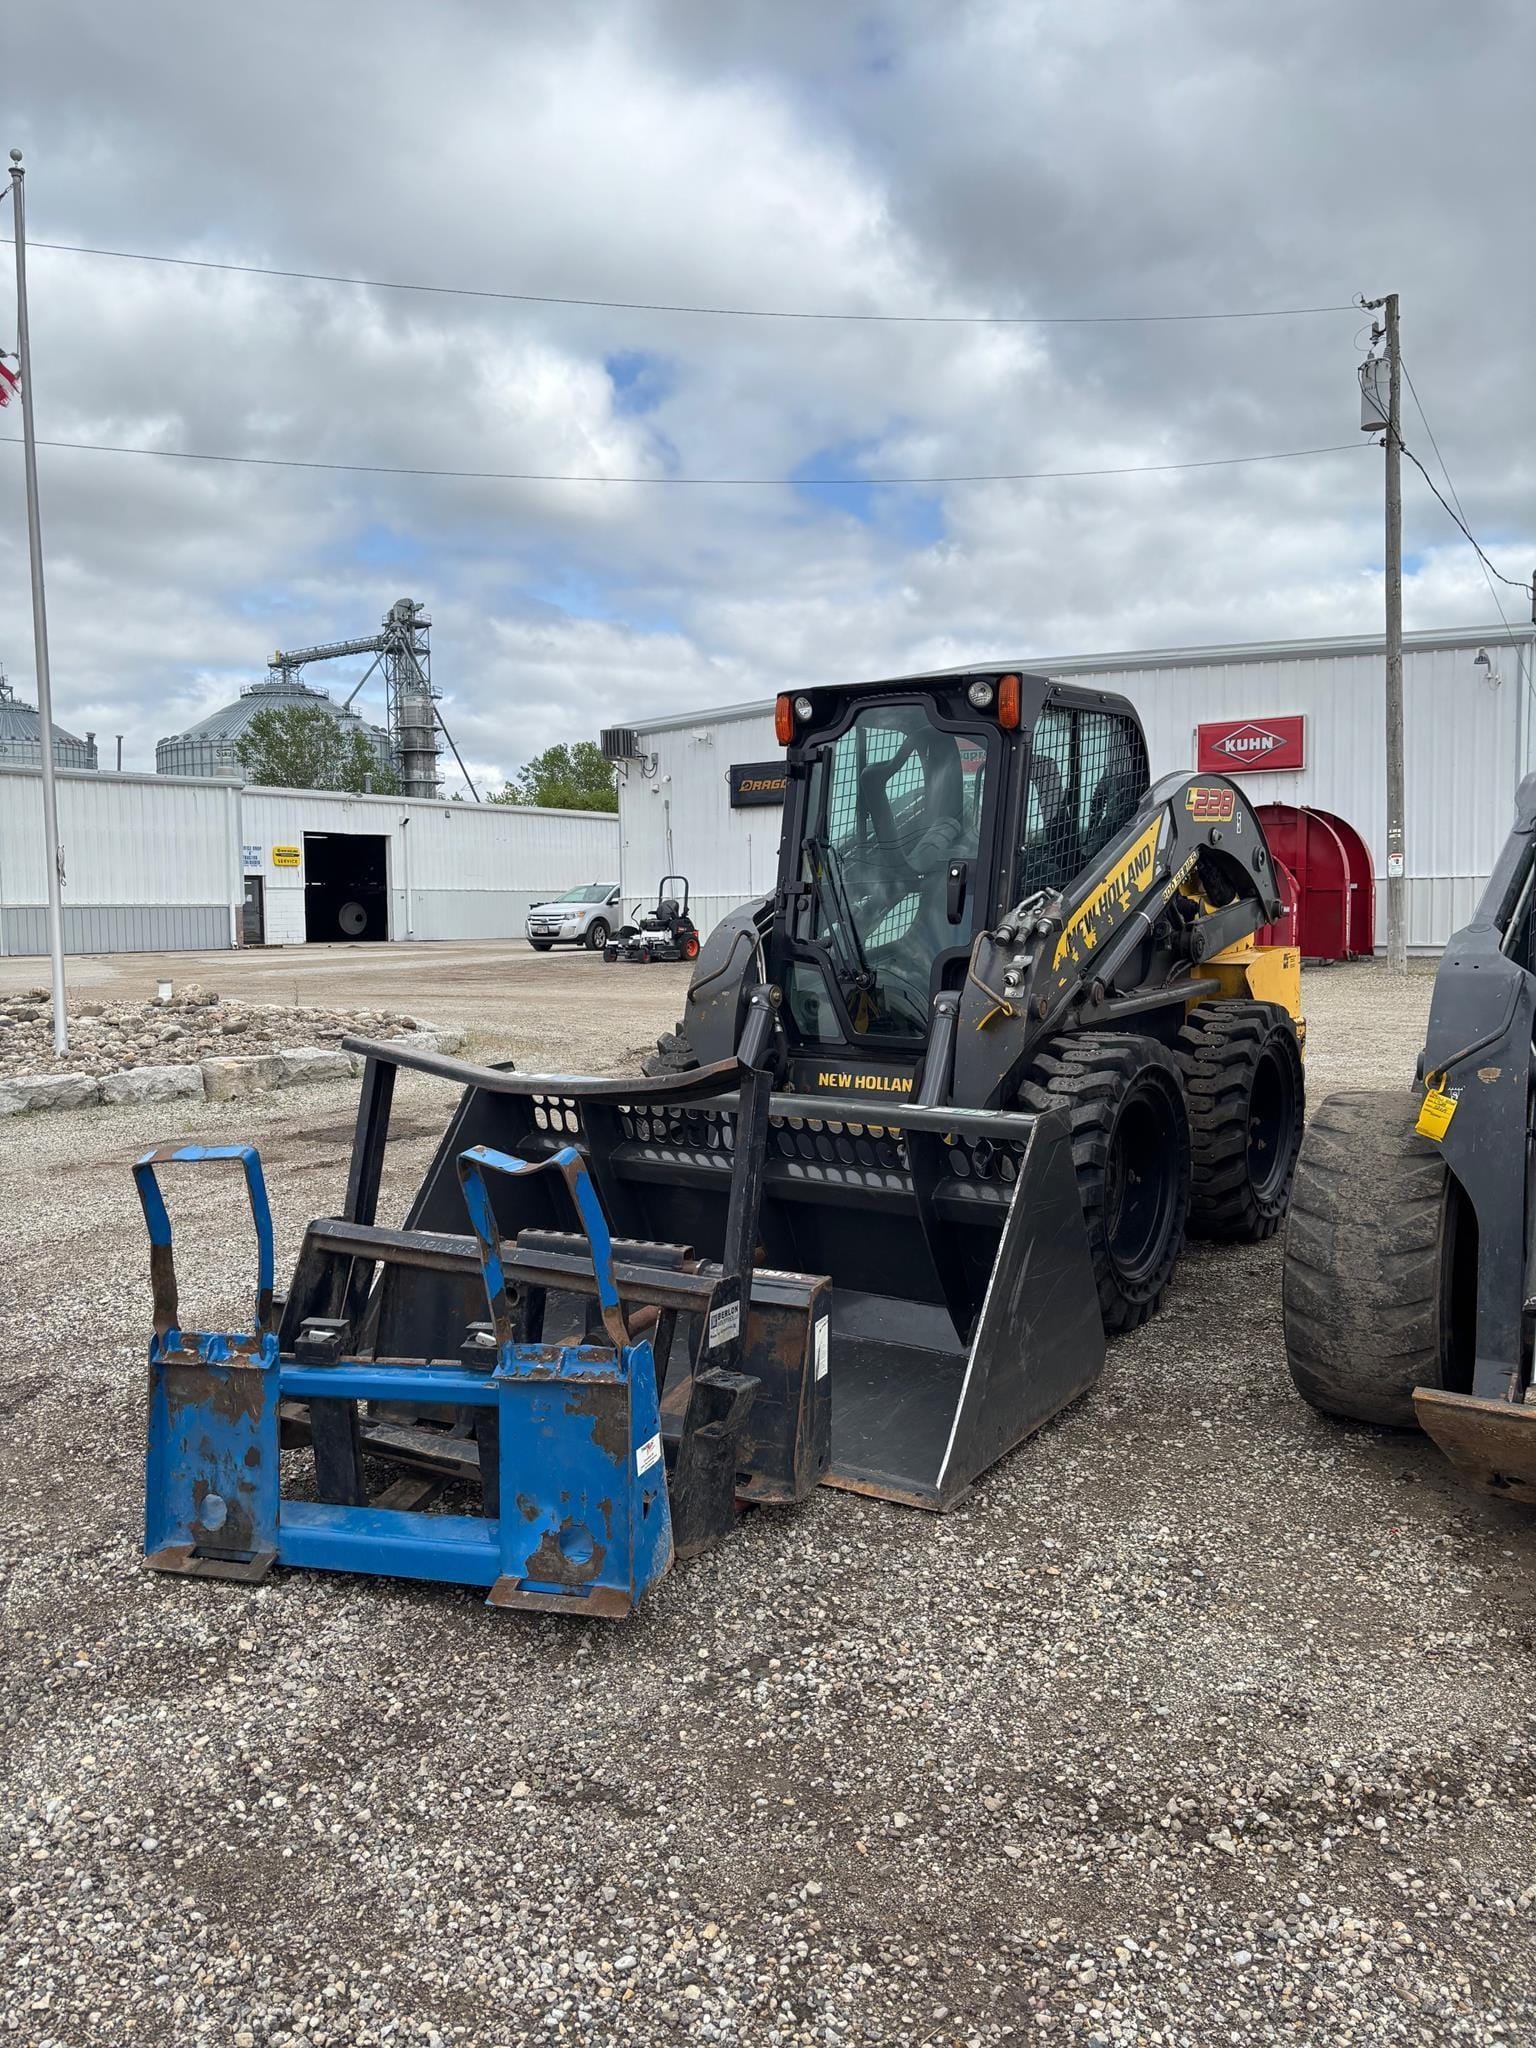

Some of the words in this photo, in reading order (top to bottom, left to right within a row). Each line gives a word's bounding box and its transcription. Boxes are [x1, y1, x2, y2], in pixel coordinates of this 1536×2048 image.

[1224, 737, 1274, 752] KUHN
[1185, 787, 1236, 822] L228
[818, 1073, 852, 1088] NEW
[854, 1076, 913, 1092] HOLLAN
